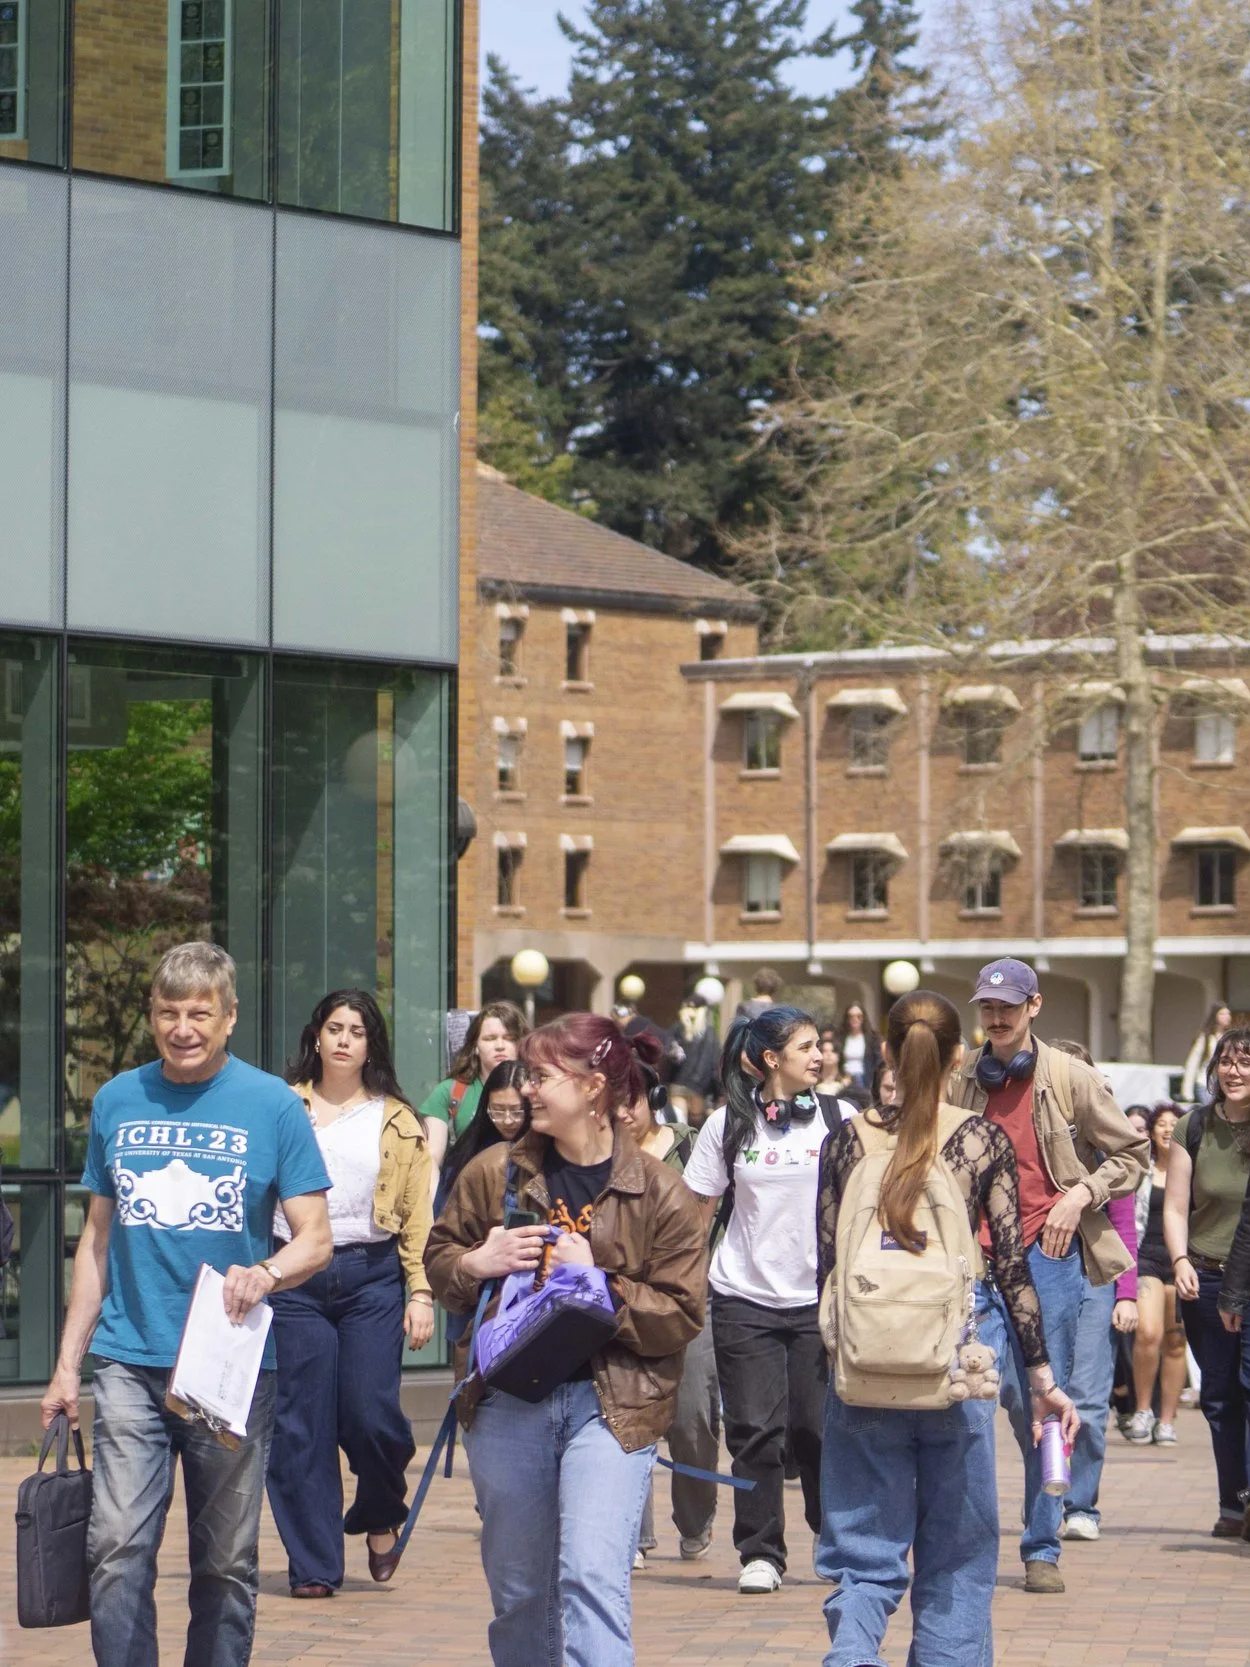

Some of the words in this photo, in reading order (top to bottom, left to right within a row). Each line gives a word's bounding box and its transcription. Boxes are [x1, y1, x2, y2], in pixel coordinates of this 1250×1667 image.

[115, 1126, 192, 1147] ICHL
[208, 1130, 248, 1154] 23
[217, 1156, 248, 1166] ANTONIO
